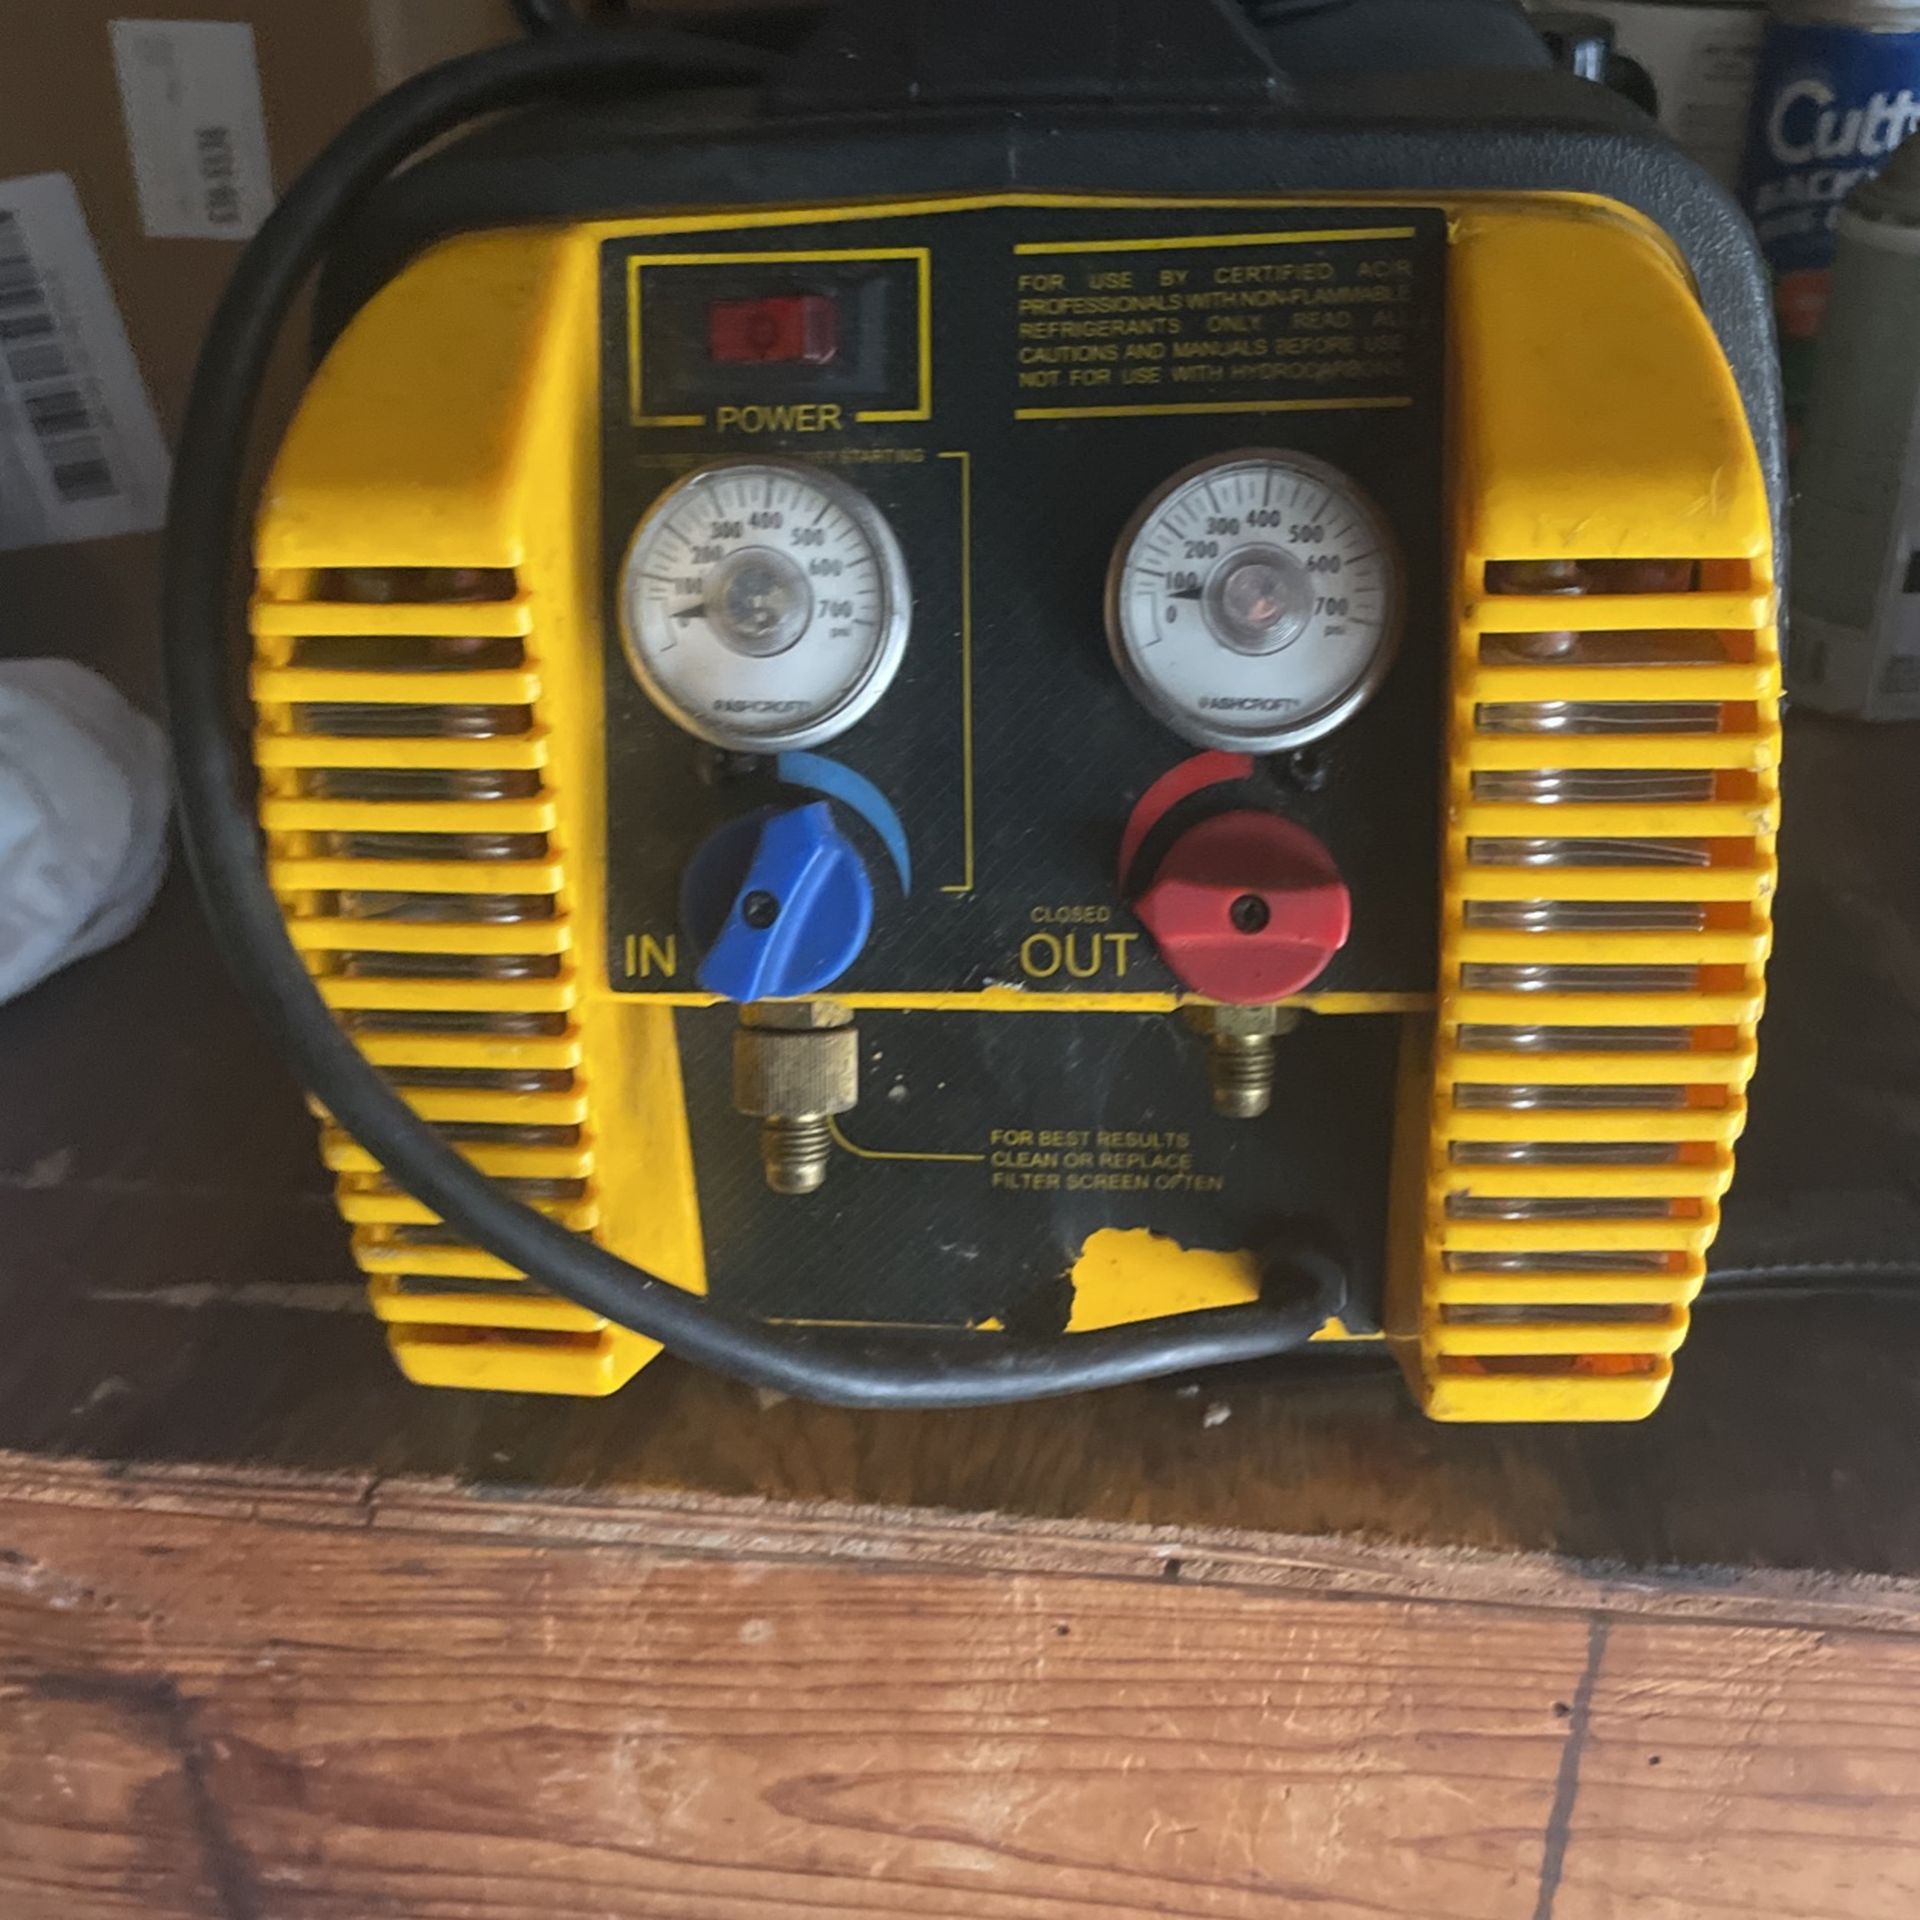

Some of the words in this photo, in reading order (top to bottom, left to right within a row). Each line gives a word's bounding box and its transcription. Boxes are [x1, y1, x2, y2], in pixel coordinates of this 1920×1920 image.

[1018, 274, 1066, 291] FOR
[1089, 272, 1133, 289] USE
[1160, 270, 1189, 287] BY
[1214, 263, 1334, 284] CERTIFIED
[1018, 295, 1182, 316] PROFESSIONALS
[1184, 291, 1238, 309] WITH
[1018, 318, 1182, 339] REFRIGERANTS
[1207, 314, 1264, 333] ONLY
[1291, 310, 1351, 330] READ
[1018, 345, 1119, 365] CAUTIONS
[1124, 342, 1165, 360] AND
[1172, 338, 1268, 359] MANUALS
[1275, 336, 1354, 355] BEFORE
[1018, 370, 1061, 388] NOT
[1069, 368, 1111, 386] FOR
[1122, 366, 1162, 384] USE
[1172, 363, 1224, 382] WITH
[716, 404, 843, 433] POWER
[1206, 517, 1241, 536] 300
[1246, 509, 1281, 528] 400
[1289, 525, 1325, 544] 500
[1183, 541, 1219, 560] 200
[1306, 556, 1341, 574] 600
[1166, 572, 1198, 590] 100
[1166, 604, 1177, 624] 0
[1315, 597, 1349, 616] 700
[1031, 906, 1111, 924] CLOSED
[625, 934, 676, 977] IN
[1020, 932, 1139, 978] OUT
[990, 1129, 1033, 1147] FOR
[1038, 1130, 1090, 1148] BEST
[1095, 1131, 1190, 1149] RESULTS
[991, 1151, 1058, 1168] CLEAN
[1063, 1152, 1095, 1169] OR
[1100, 1153, 1193, 1170] REPLACE
[991, 1171, 1060, 1190] FILTER
[1066, 1173, 1149, 1191] SCREEN
[1154, 1174, 1224, 1192] OFTEN
